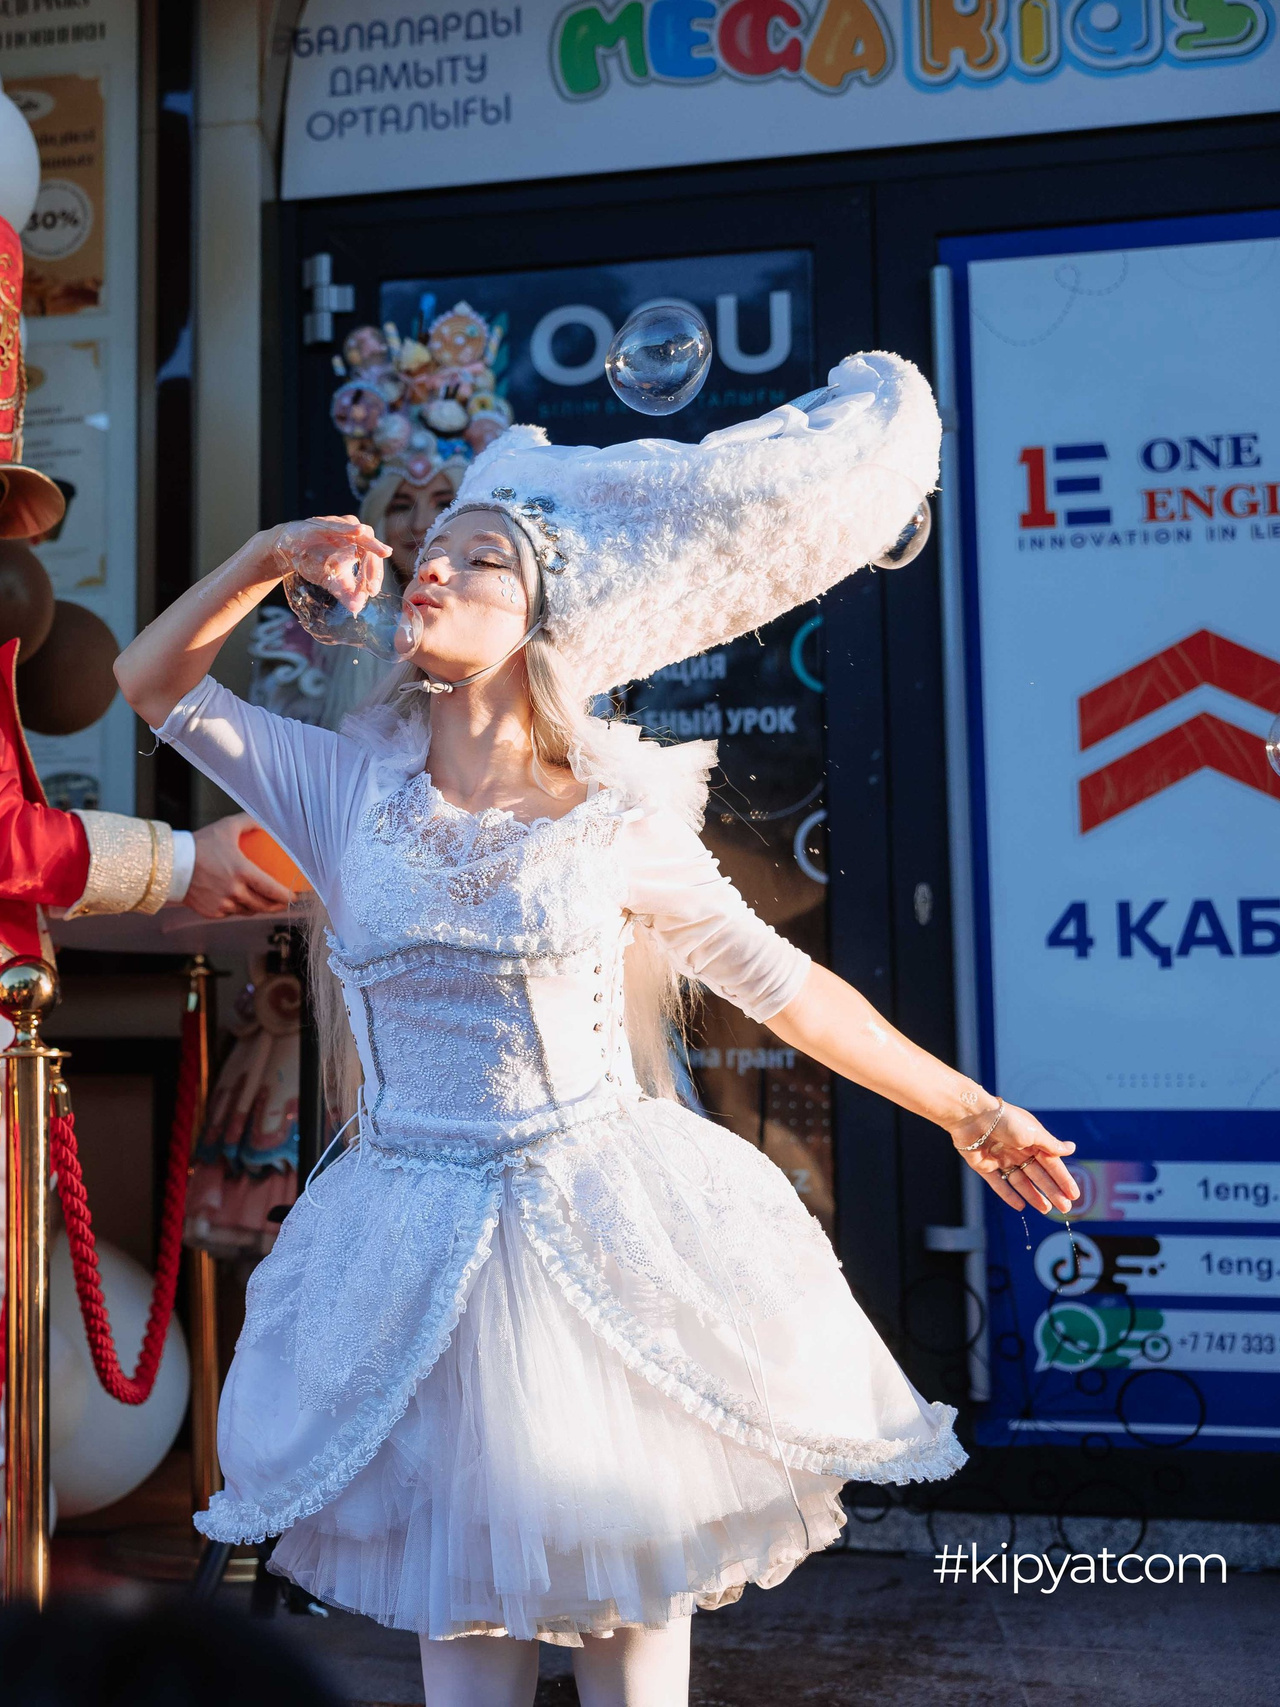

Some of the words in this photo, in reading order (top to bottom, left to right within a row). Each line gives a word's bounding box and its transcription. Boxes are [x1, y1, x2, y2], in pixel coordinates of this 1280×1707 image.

[293, 6, 522, 58] БАЛАЛАРДЫ
[554, 0, 892, 98] MEGA
[329, 52, 487, 97] ДАМЫТУ
[306, 92, 512, 141] ОРТАЛЫҒЫ
[530, 290, 792, 386] OU
[1140, 433, 1261, 473] ONE
[1019, 526, 1191, 551] INNOVATION
[1208, 524, 1237, 542] IN
[726, 706, 797, 735] УРОК
[1045, 901, 1095, 959] 4
[1178, 1332, 1199, 1352] +7
[1204, 1332, 1237, 1353] 747
[1242, 1332, 1275, 1355] 333
